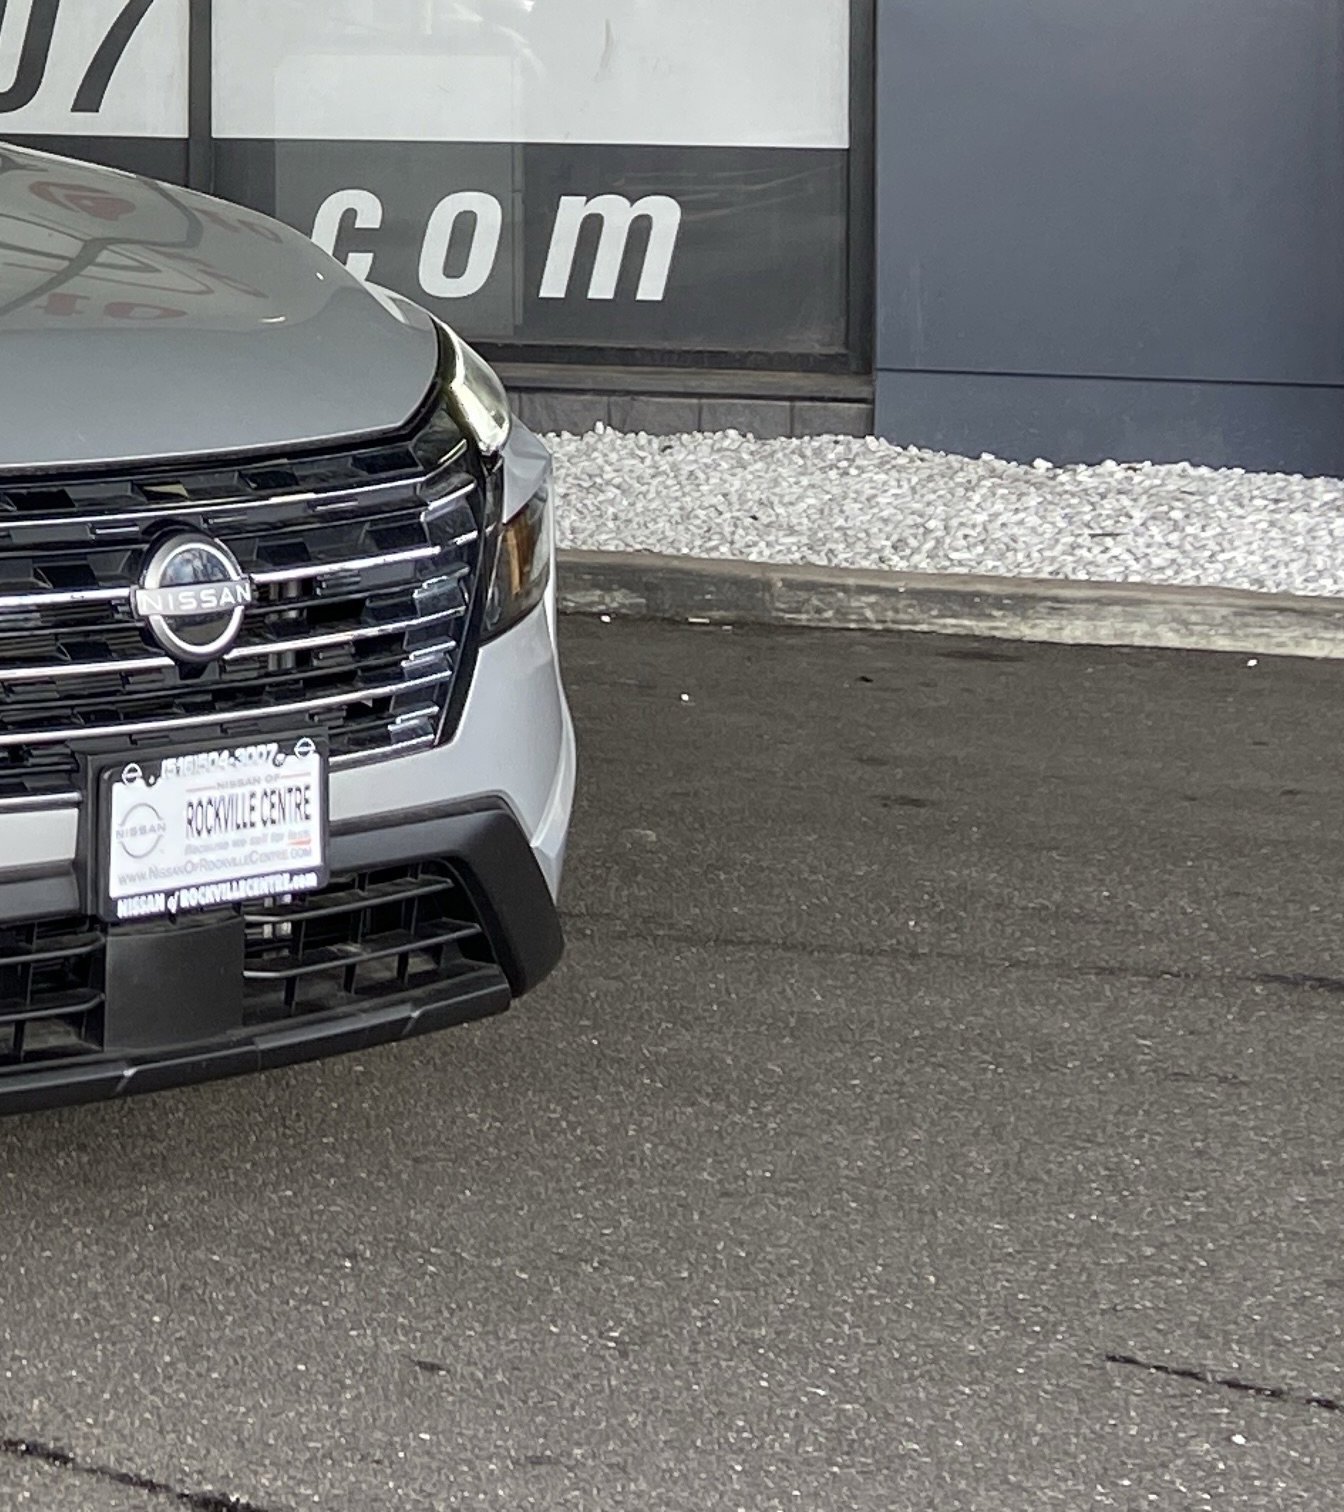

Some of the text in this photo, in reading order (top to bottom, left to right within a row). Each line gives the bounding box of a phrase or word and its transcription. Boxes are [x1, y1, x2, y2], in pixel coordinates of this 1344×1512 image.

[140, 582, 251, 612] NISSAN
[217, 776, 262, 790] NISSAN
[185, 784, 312, 838] ROCKVILLE CENTRE
[116, 822, 167, 840] NISSAN
[117, 893, 166, 919] NISSAN
